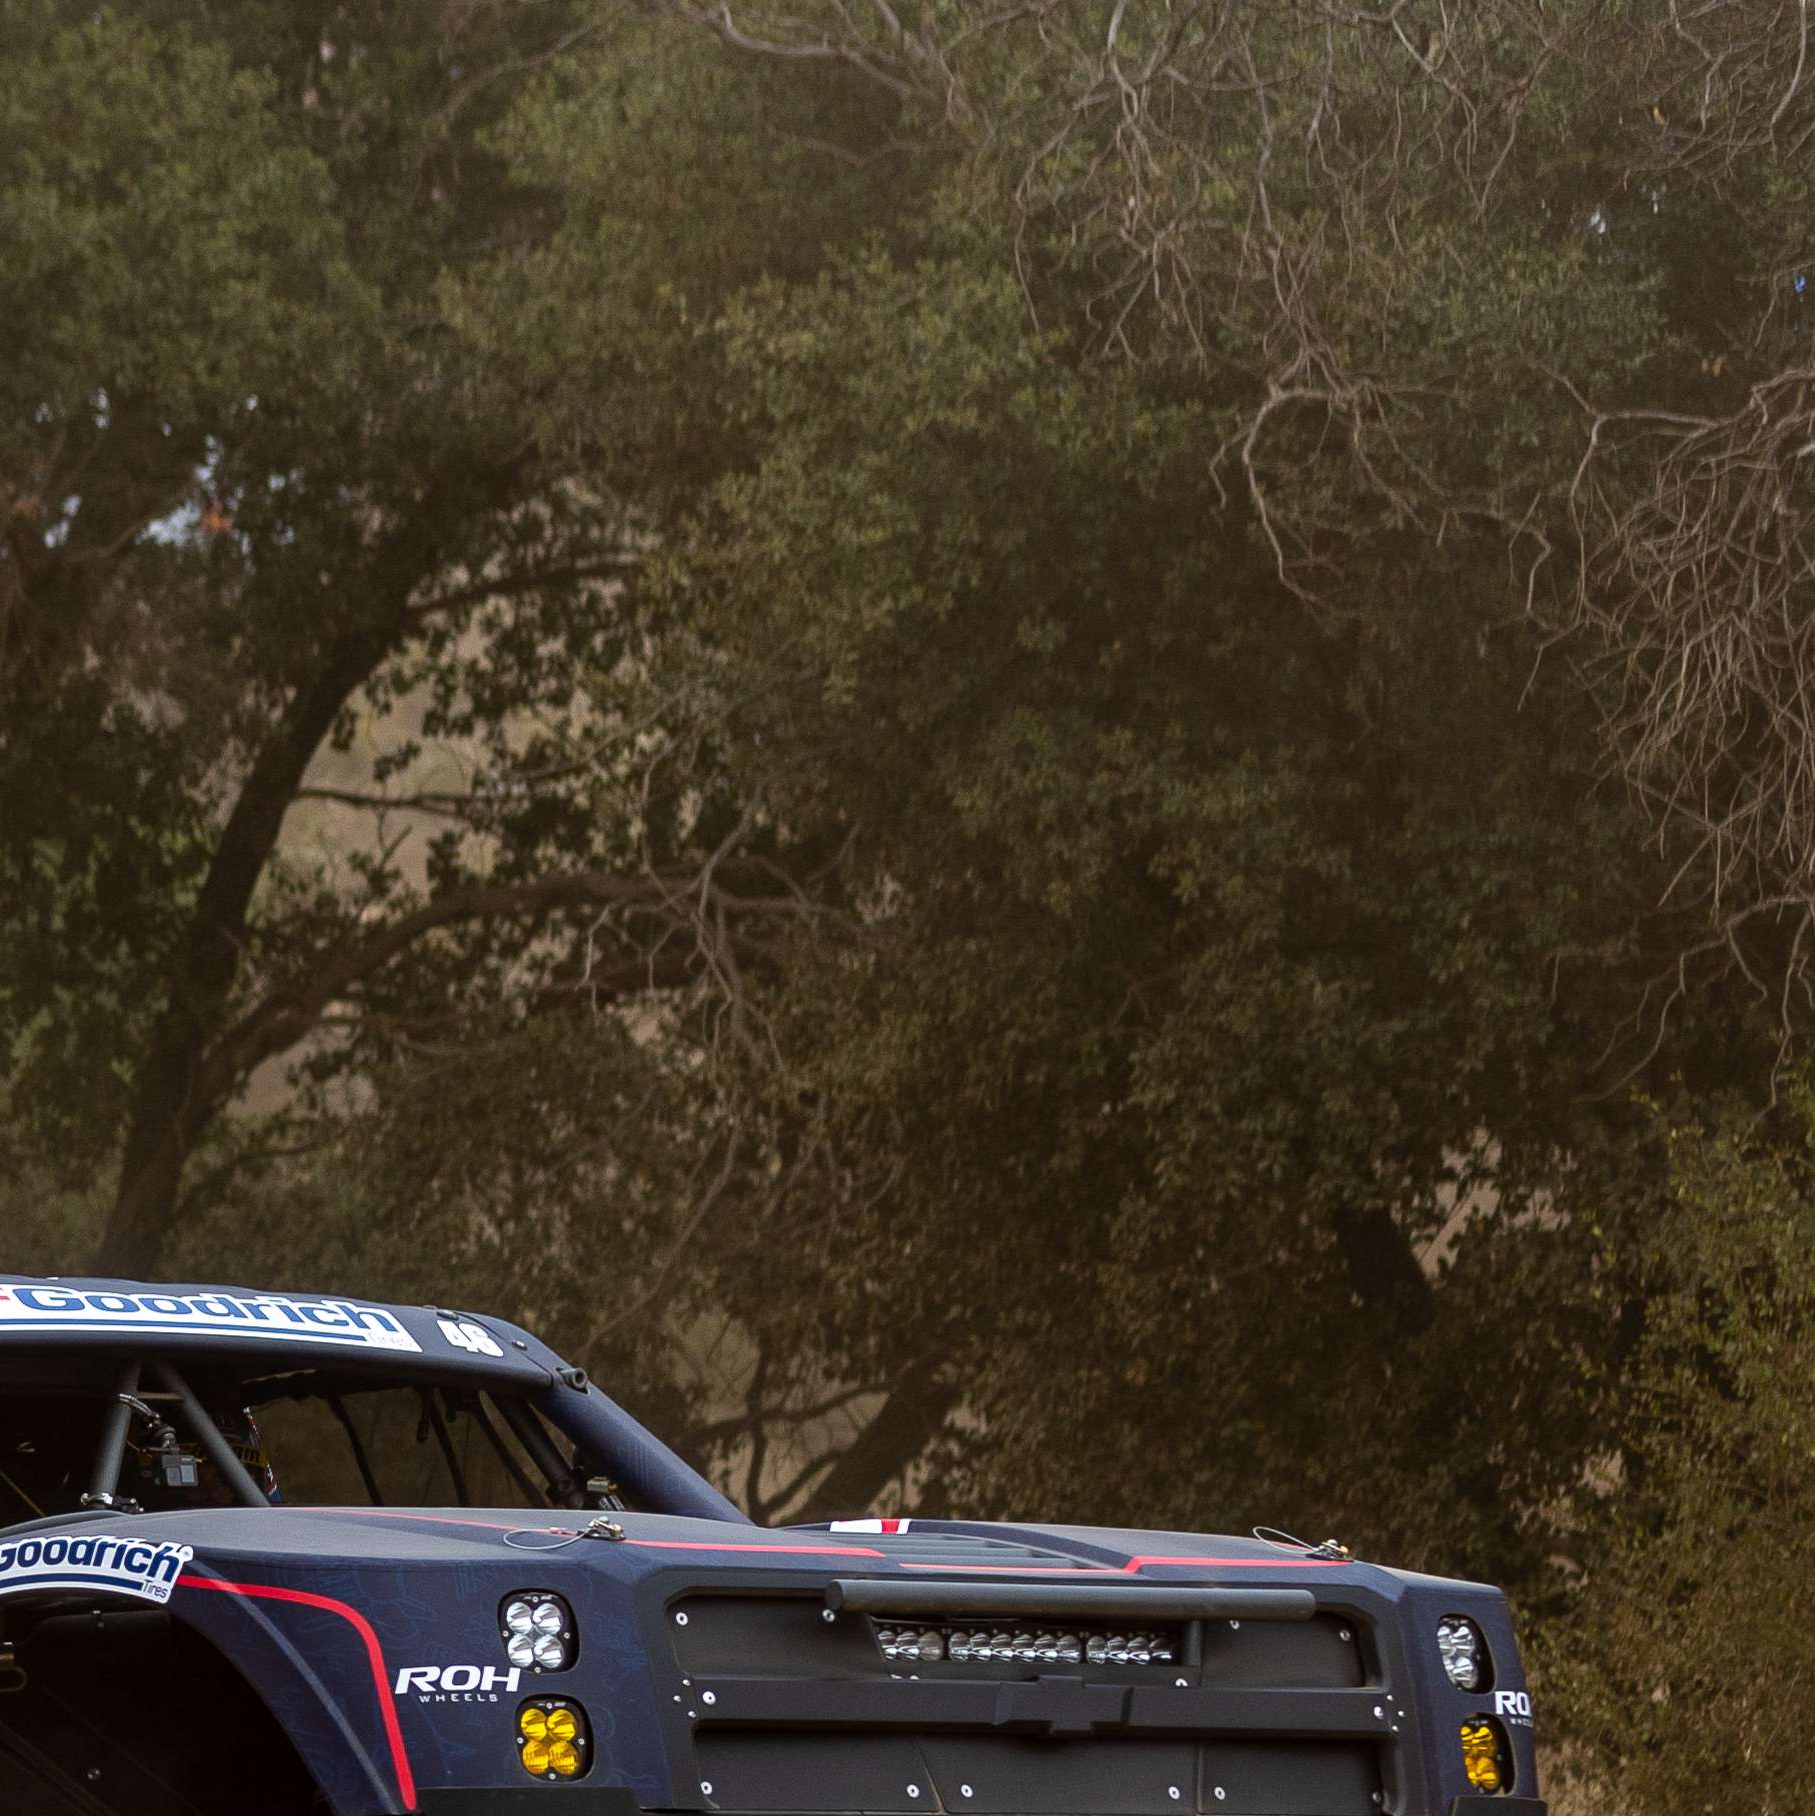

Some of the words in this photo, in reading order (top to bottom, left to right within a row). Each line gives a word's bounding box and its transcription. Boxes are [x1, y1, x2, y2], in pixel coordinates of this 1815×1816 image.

[436, 1320, 504, 1358] 46
[142, 1579, 169, 1598] Tires
[394, 1665, 522, 1694] ROH
[419, 1693, 498, 1703] WHEELS
[1494, 1690, 1532, 1717] RO
